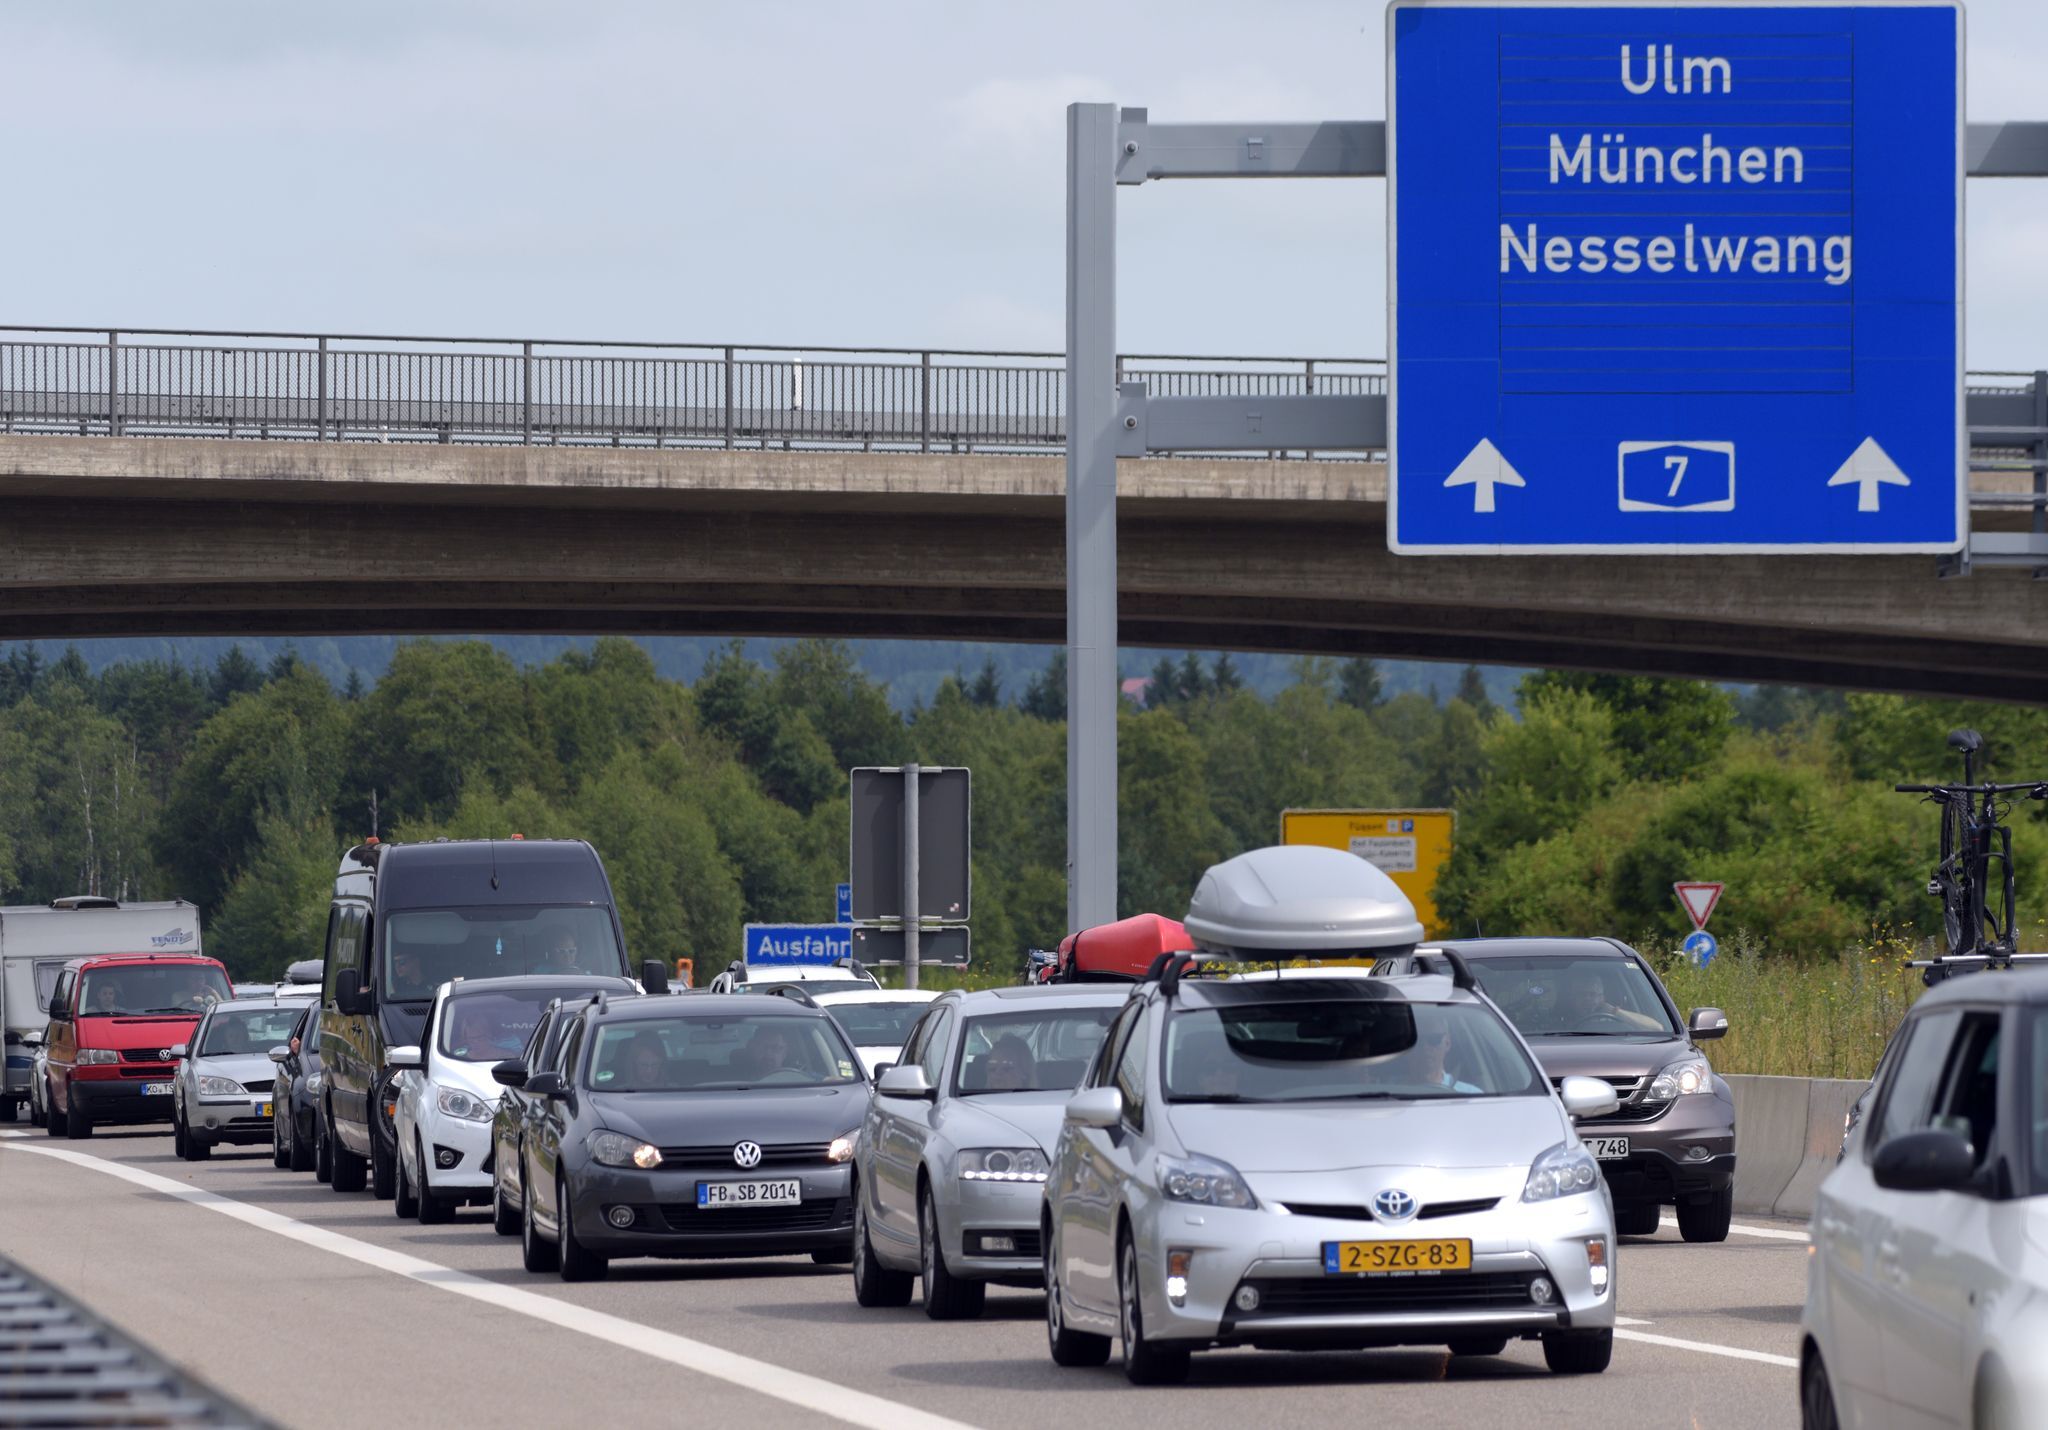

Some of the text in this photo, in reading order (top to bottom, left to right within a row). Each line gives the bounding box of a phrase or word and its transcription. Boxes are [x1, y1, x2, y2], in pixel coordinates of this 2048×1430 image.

[1620, 44, 1732, 95] Ulm
[1549, 132, 1804, 184] München
[1499, 222, 1853, 286] Nesselwang
[1663, 455, 1690, 498] 7
[758, 936, 851, 957] Ausfahr
[1597, 1139, 1627, 1155] 748
[708, 1182, 797, 1202] FB SB 2014
[1348, 1244, 1458, 1267] 2-SZG-83
